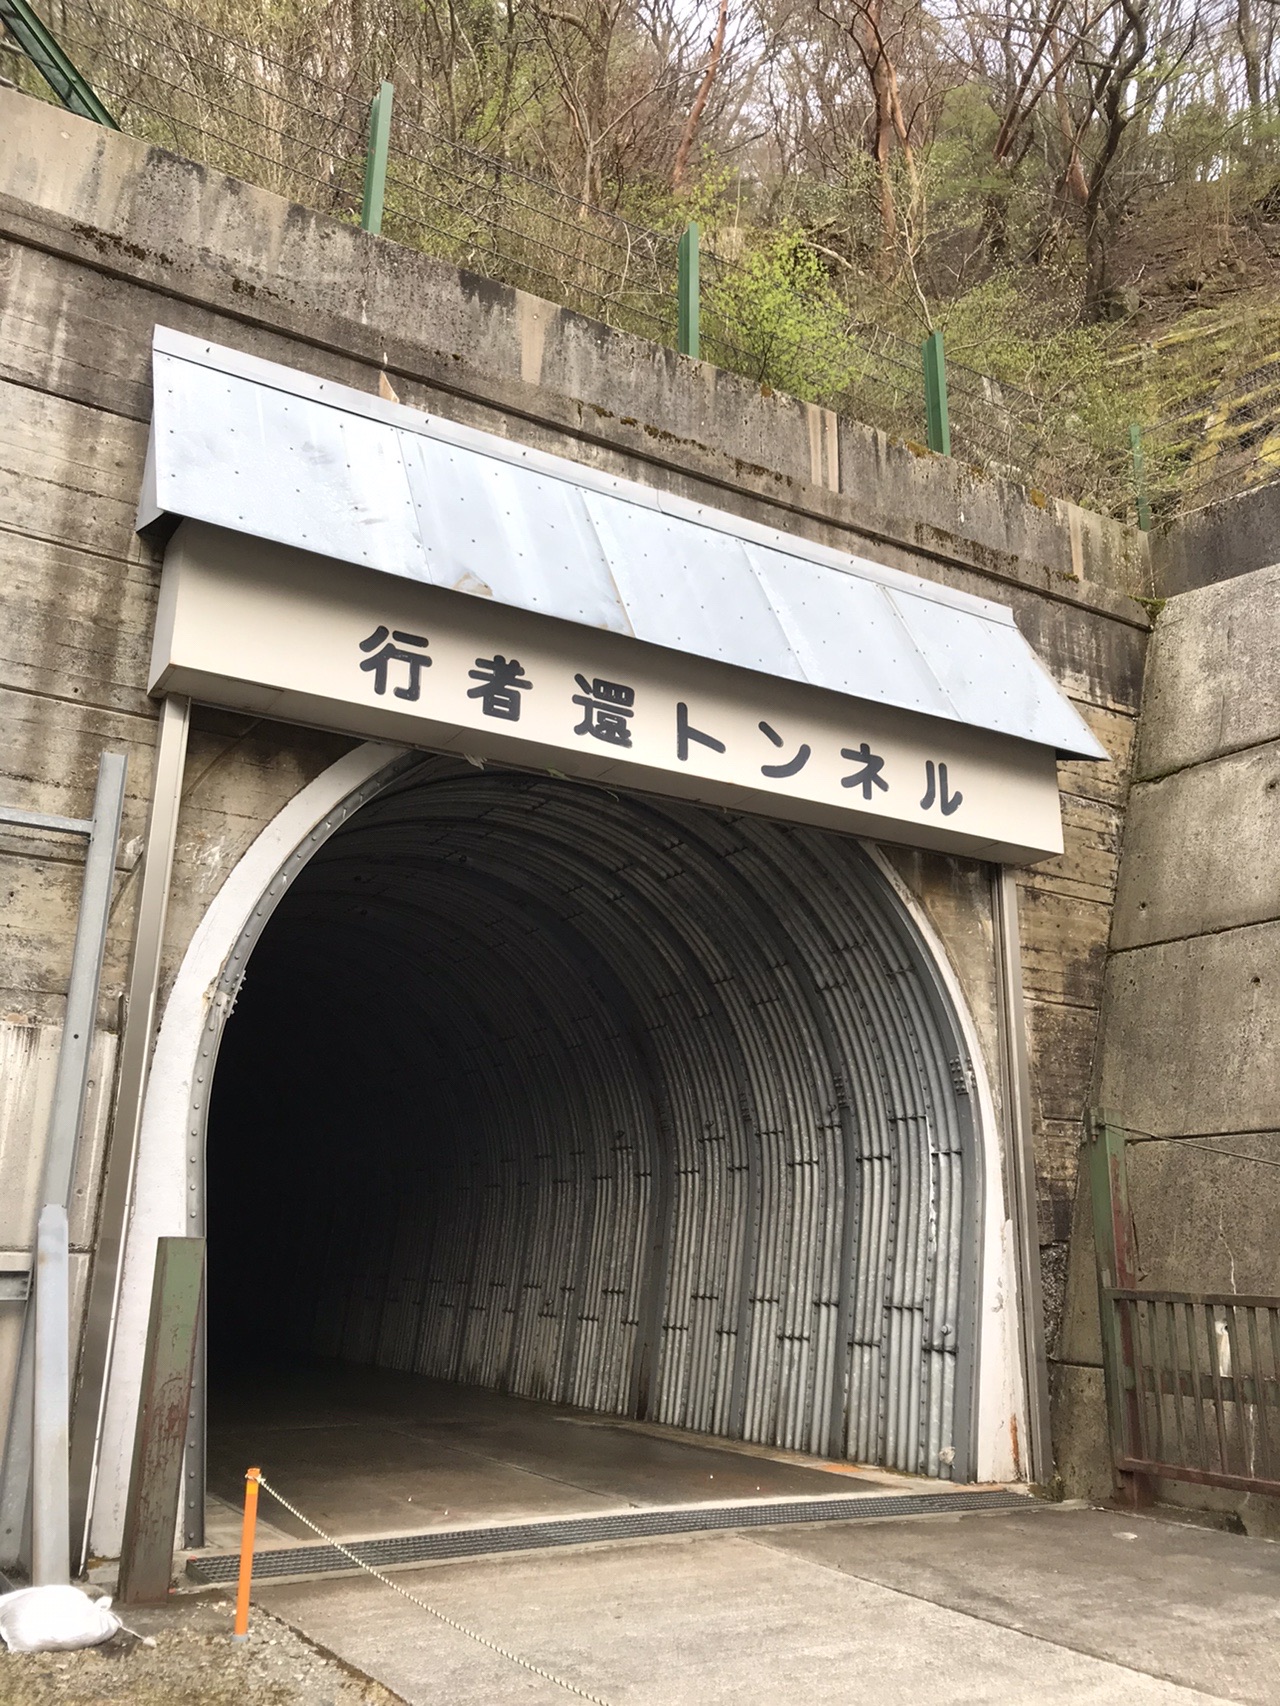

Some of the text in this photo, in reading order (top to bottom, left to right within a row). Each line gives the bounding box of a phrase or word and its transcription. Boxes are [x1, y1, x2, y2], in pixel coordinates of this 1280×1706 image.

[359, 625, 963, 816] 行者還トンネル
